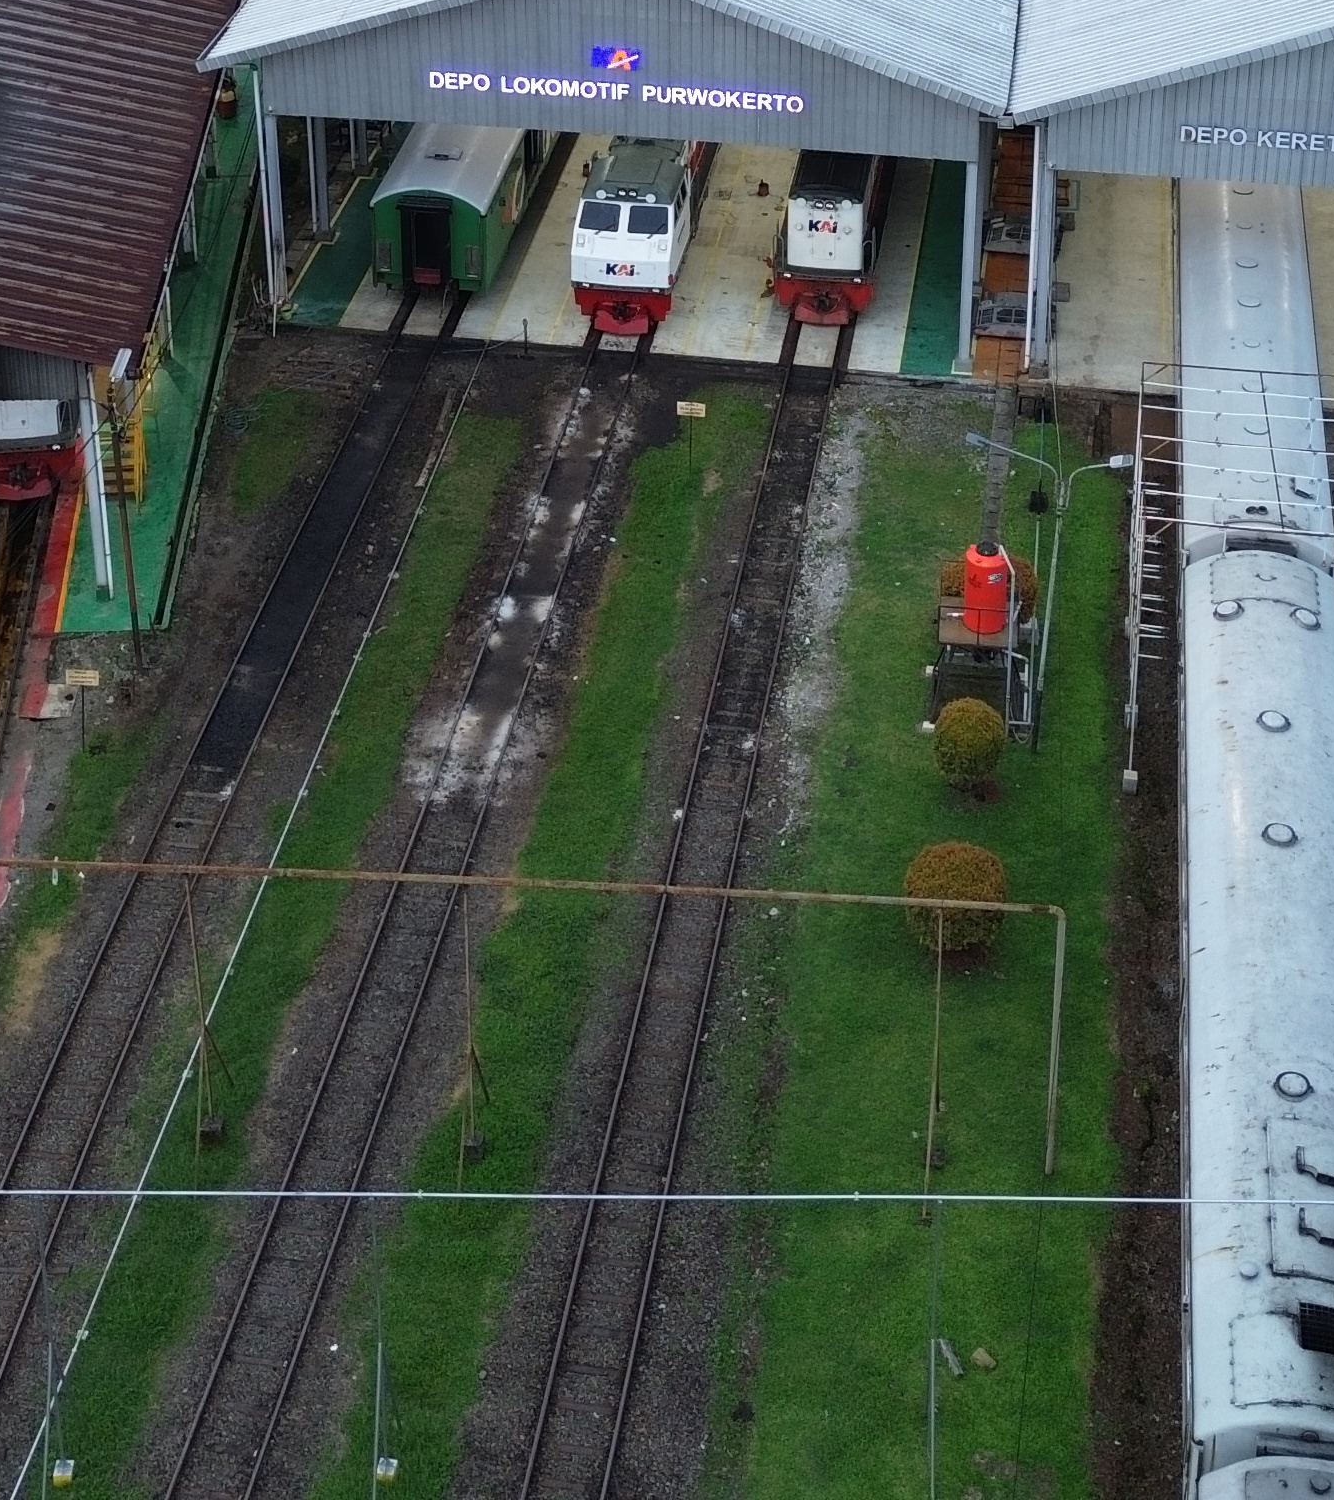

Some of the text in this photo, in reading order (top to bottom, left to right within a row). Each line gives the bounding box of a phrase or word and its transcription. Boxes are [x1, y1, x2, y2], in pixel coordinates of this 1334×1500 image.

[429, 71, 804, 113] DEPO LOKOMOTIF PURWOKERTO
[1180, 125, 1247, 146] DEPO
